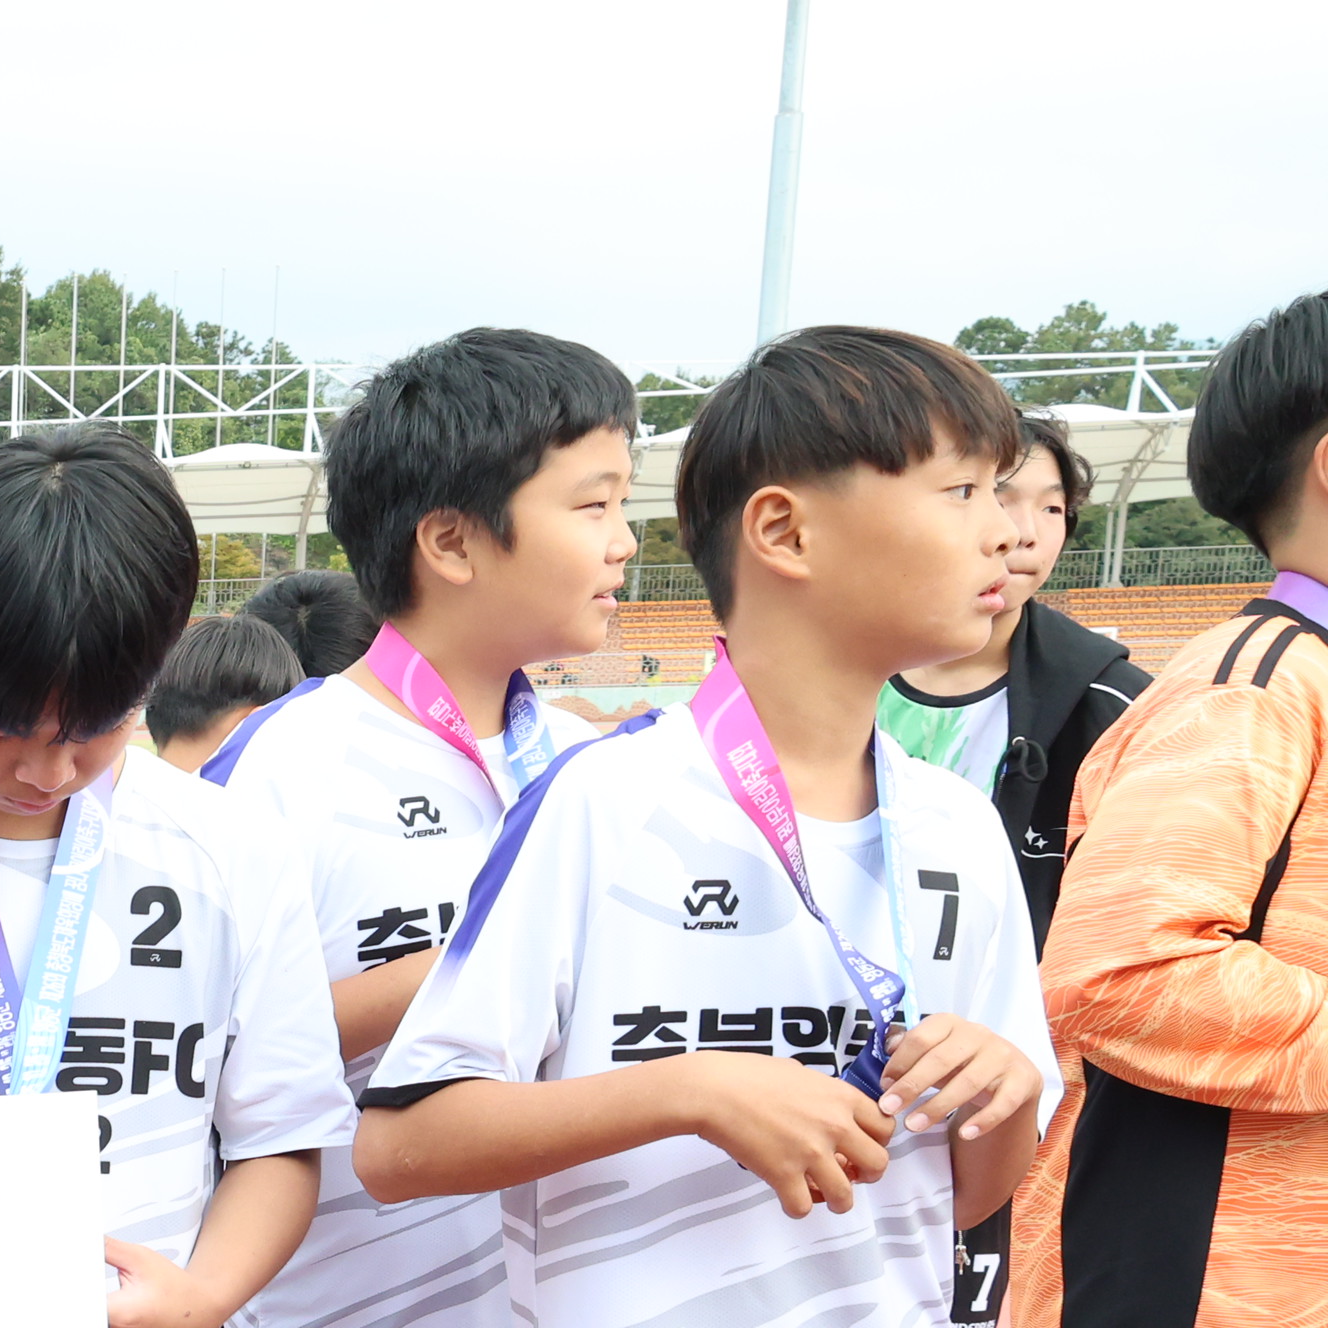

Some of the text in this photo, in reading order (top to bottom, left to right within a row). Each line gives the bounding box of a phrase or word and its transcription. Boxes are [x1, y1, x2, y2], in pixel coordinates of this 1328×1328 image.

[727, 740, 795, 841] 꿈나무어린이축구대회
[403, 826, 448, 839] WERUN
[129, 886, 183, 969] 2
[683, 919, 739, 930] WERUN
[917, 869, 960, 961] 7
[970, 1253, 1001, 1312] 7
